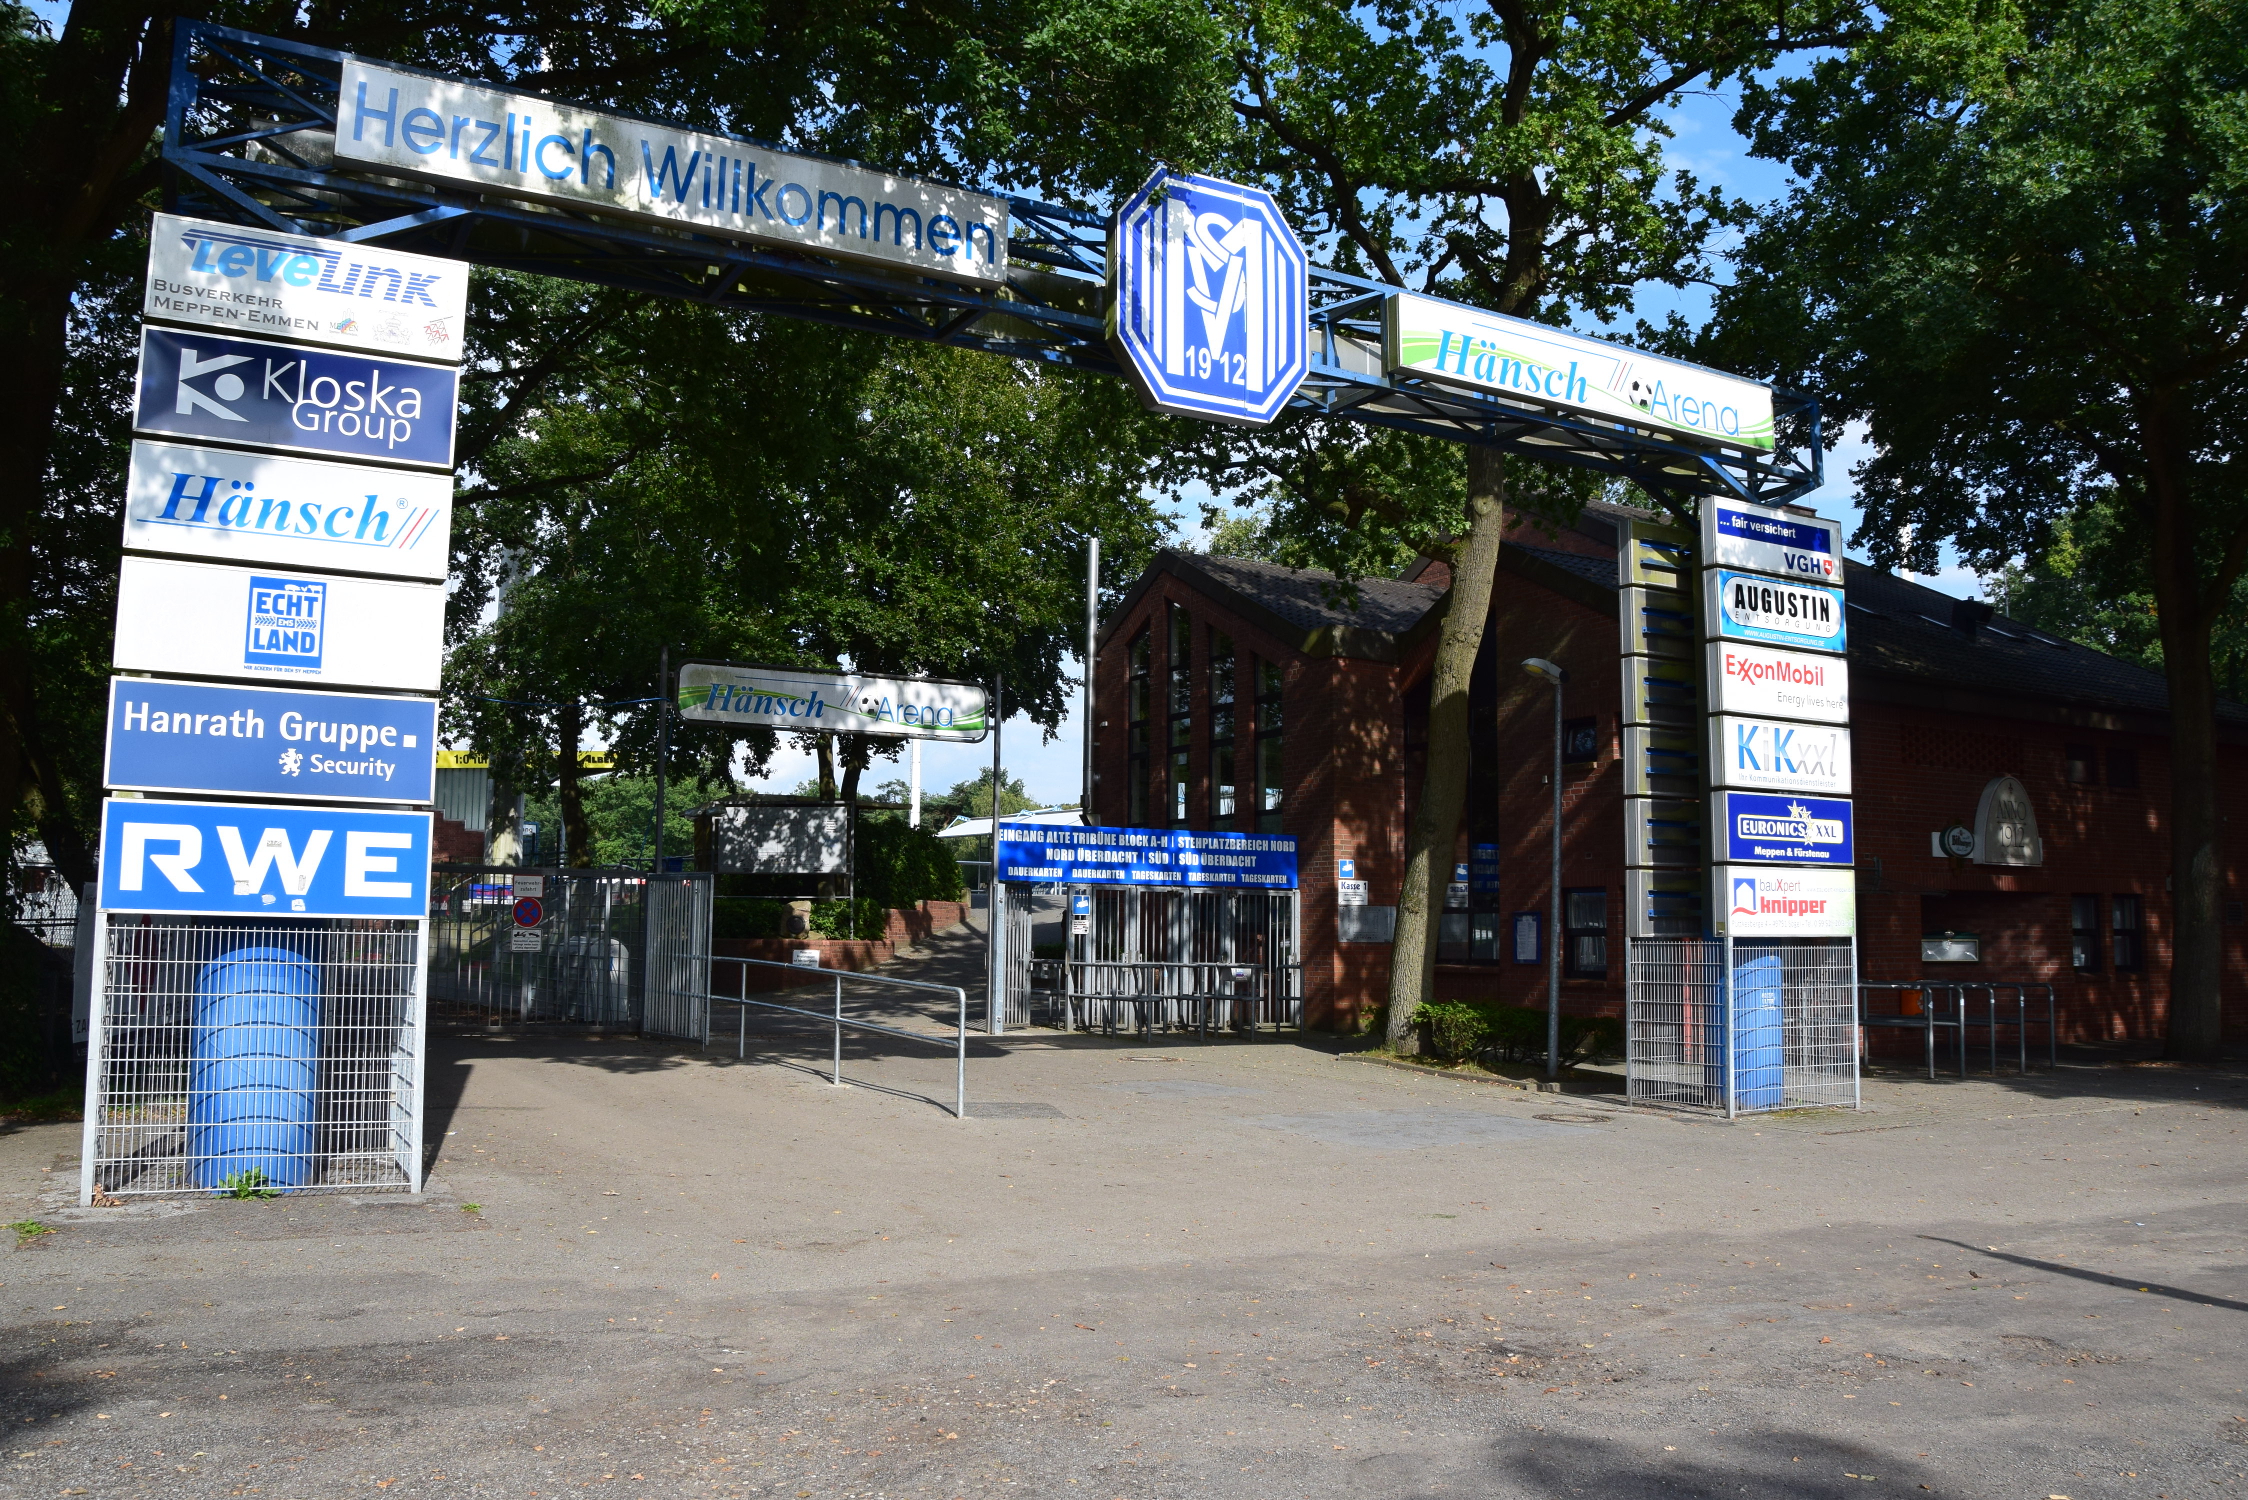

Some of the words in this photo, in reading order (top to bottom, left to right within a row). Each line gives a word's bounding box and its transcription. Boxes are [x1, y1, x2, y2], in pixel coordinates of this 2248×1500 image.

[353, 81, 615, 190] Herzlich
[640, 139, 995, 265] Willkommen
[153, 279, 283, 310] BUSVERKEHR
[154, 295, 320, 331] MEPPEN-EMMEN
[263, 358, 422, 420] Kloska
[1433, 328, 1588, 404] Hänsch
[1649, 379, 1740, 437] Arena
[292, 398, 412, 450] Group
[1732, 515, 1748, 530] fair
[1750, 519, 1797, 539] versichert
[1784, 552, 1821, 575] VGH
[256, 591, 318, 618] ECHT
[1734, 583, 1830, 623] AUGUSTIN
[278, 619, 294, 627] EMS
[253, 628, 316, 653] LAND
[1725, 653, 1824, 687] ExxonMobil
[705, 682, 825, 719] Hänsch
[875, 696, 954, 728] Arena
[1777, 691, 1805, 708] Energy
[1806, 695, 1824, 708] lives
[123, 700, 264, 738] Hanrath
[310, 754, 396, 782] Security
[1996, 800, 2027, 821] ANNO
[998, 828, 1045, 843] EINGANG
[1046, 830, 1071, 844] ALTE
[1072, 831, 1117, 846] TRIBÜNE
[1119, 834, 1149, 847] BLOCK
[1151, 835, 1168, 848] A-H
[1178, 835, 1268, 851] STEHPLATZBEREICH
[1271, 840, 1295, 852] NORD
[1742, 819, 1806, 837] EURONICS
[1815, 824, 1837, 838] XXL
[2000, 826, 2025, 848] 1912
[119, 822, 413, 898] RWE
[1046, 848, 1075, 861] NORD
[1077, 847, 1138, 864] ÜBERDACHT
[1148, 850, 1169, 865] SÜD
[1179, 851, 1199, 866] SÜD
[1201, 852, 1257, 867] ÜBERDACHT
[1754, 846, 1785, 858] Meppen
[1786, 848, 1793, 857] &
[1794, 848, 1830, 859] Fürstenau
[1008, 866, 1063, 878] DAUERKARTEN
[1072, 868, 1125, 880] DAUERKARTEN
[1131, 870, 1182, 881] TAGESKARTEN
[1188, 872, 1236, 882] TAGESKARTEN
[1241, 874, 1287, 884] TAGESKARTEN
[1341, 881, 1361, 891] Kasse
[1363, 882, 1367, 891] 1
[1759, 878, 1801, 894] bauXpert
[1760, 896, 1827, 917] knipper
